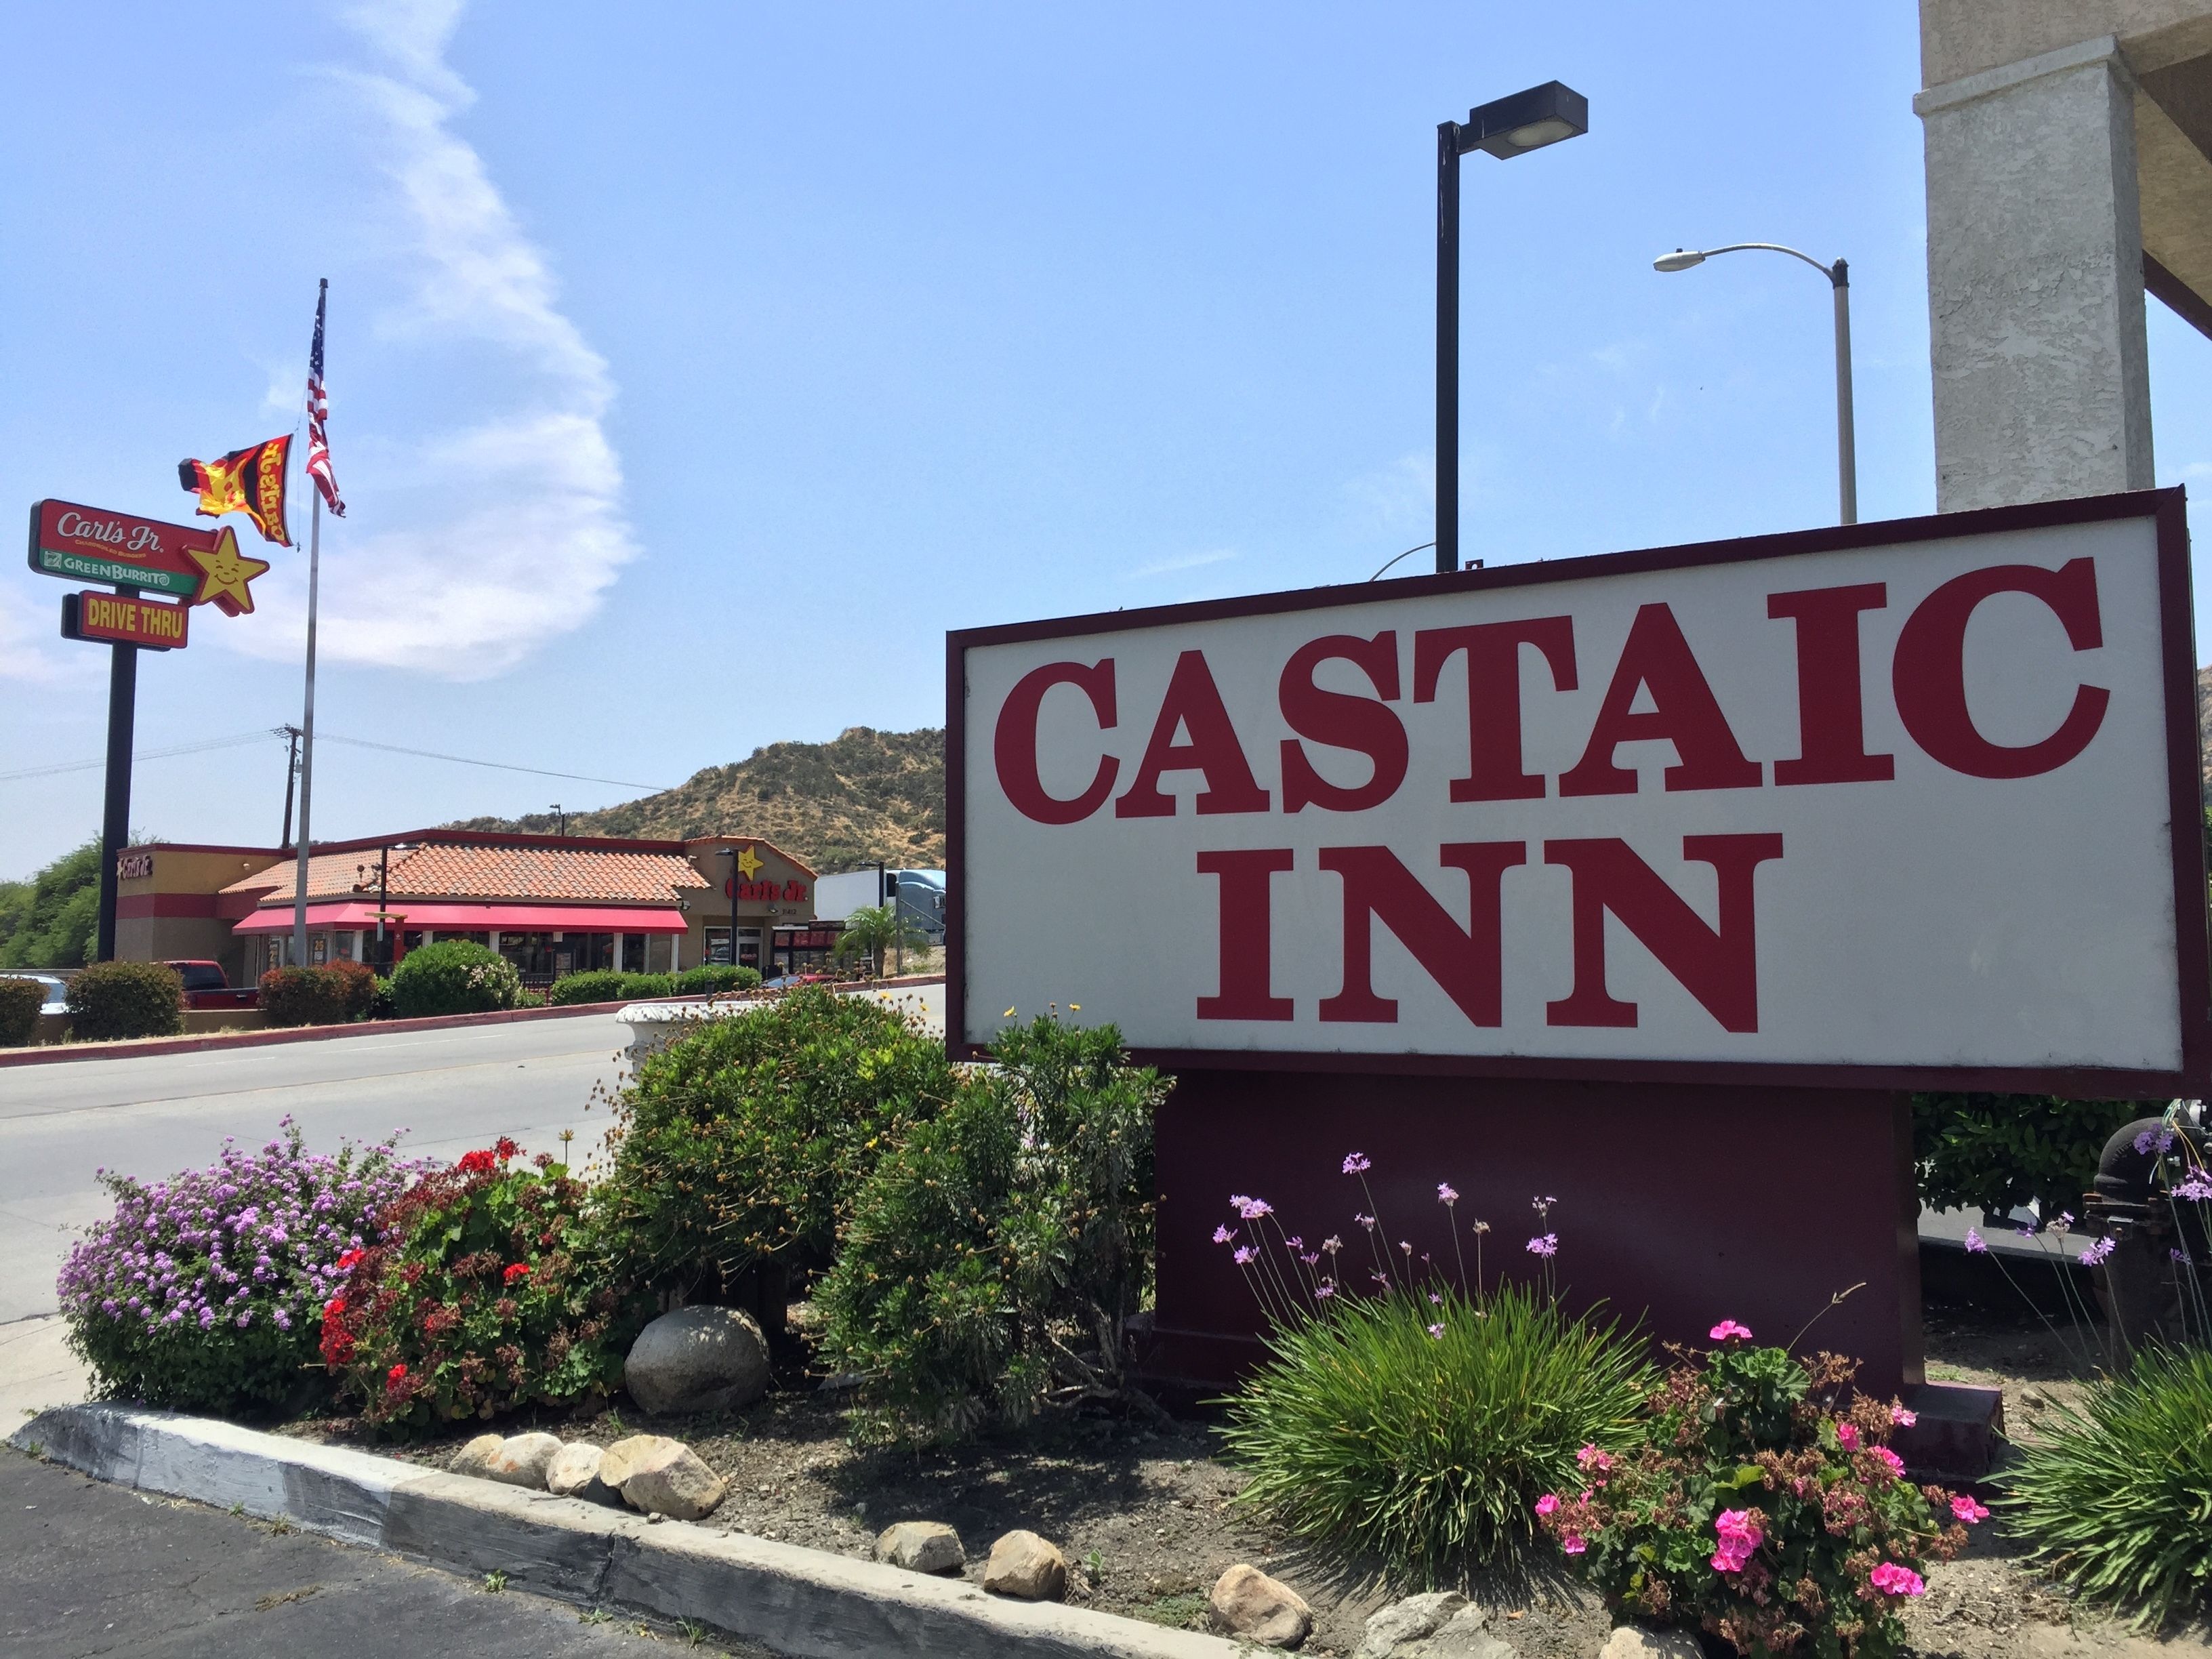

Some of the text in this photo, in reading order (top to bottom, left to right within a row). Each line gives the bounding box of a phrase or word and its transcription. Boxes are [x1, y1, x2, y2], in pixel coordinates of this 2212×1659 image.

[57, 512, 164, 553] Carl's Jr.
[88, 598, 183, 638] DRIVE THRU
[994, 558, 2108, 825] CASTAIC
[1197, 834, 1782, 1032] INN
